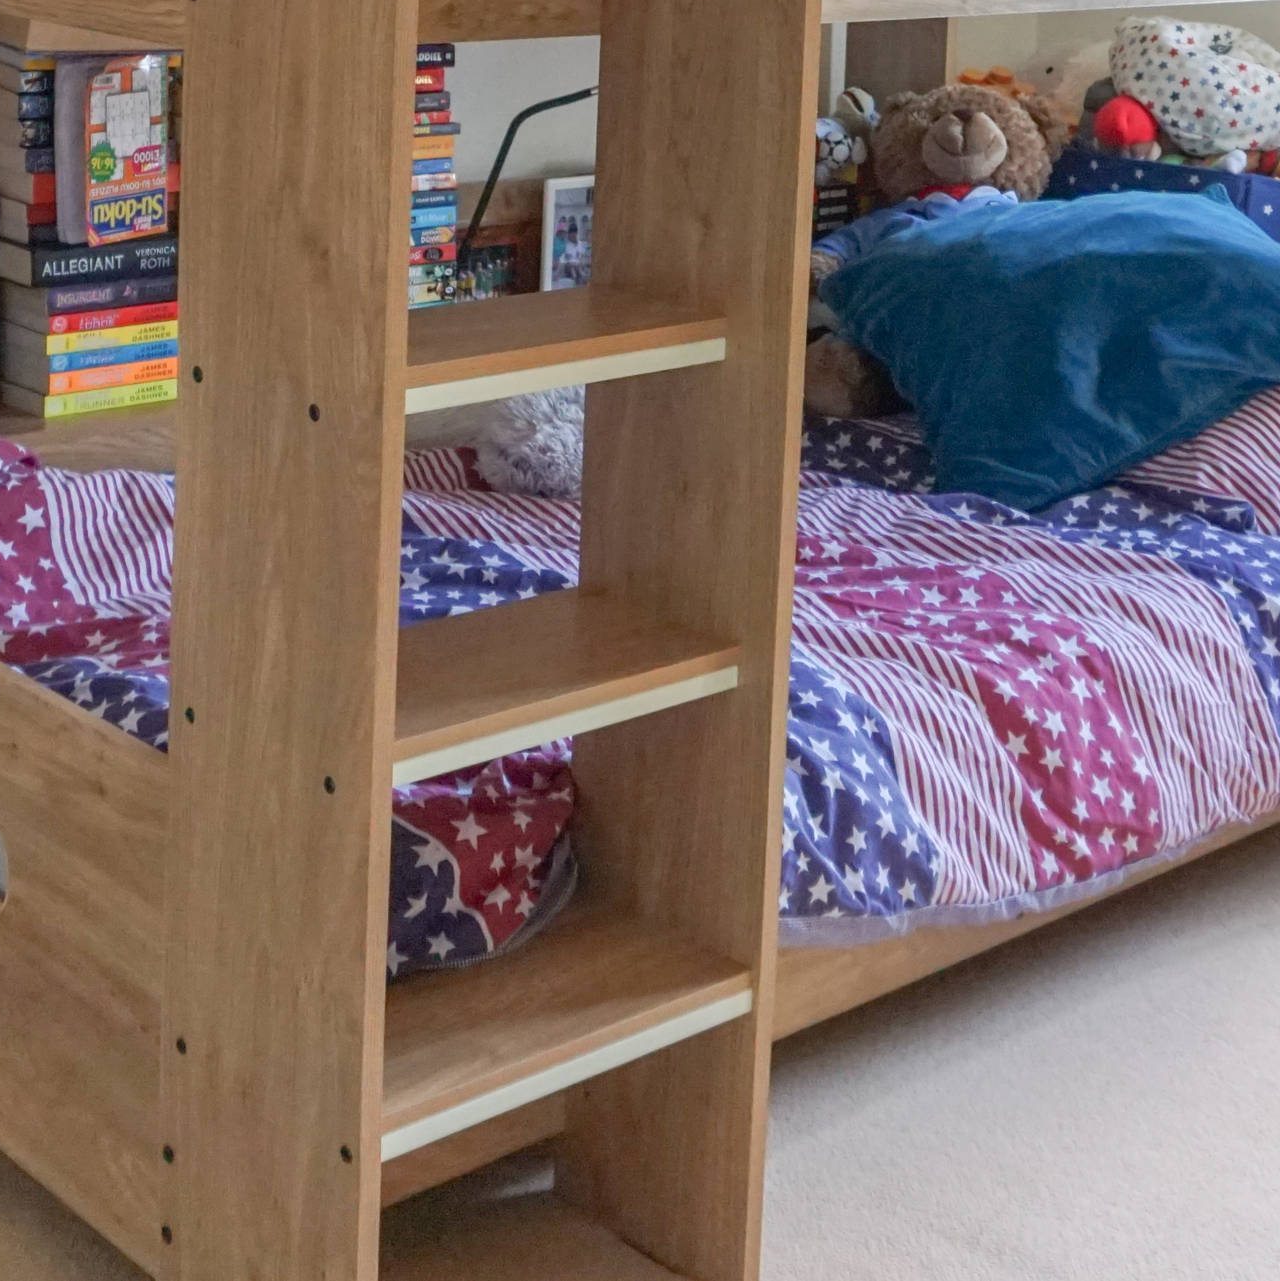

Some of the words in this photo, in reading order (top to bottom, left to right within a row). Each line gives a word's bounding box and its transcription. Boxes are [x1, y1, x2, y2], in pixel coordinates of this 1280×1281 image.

[93, 193, 163, 229] Su-doku
[135, 246, 176, 257] VERONICA
[41, 254, 125, 278] ALLEGIANT
[140, 257, 170, 271] ROTH
[134, 384, 164, 396] JAMES
